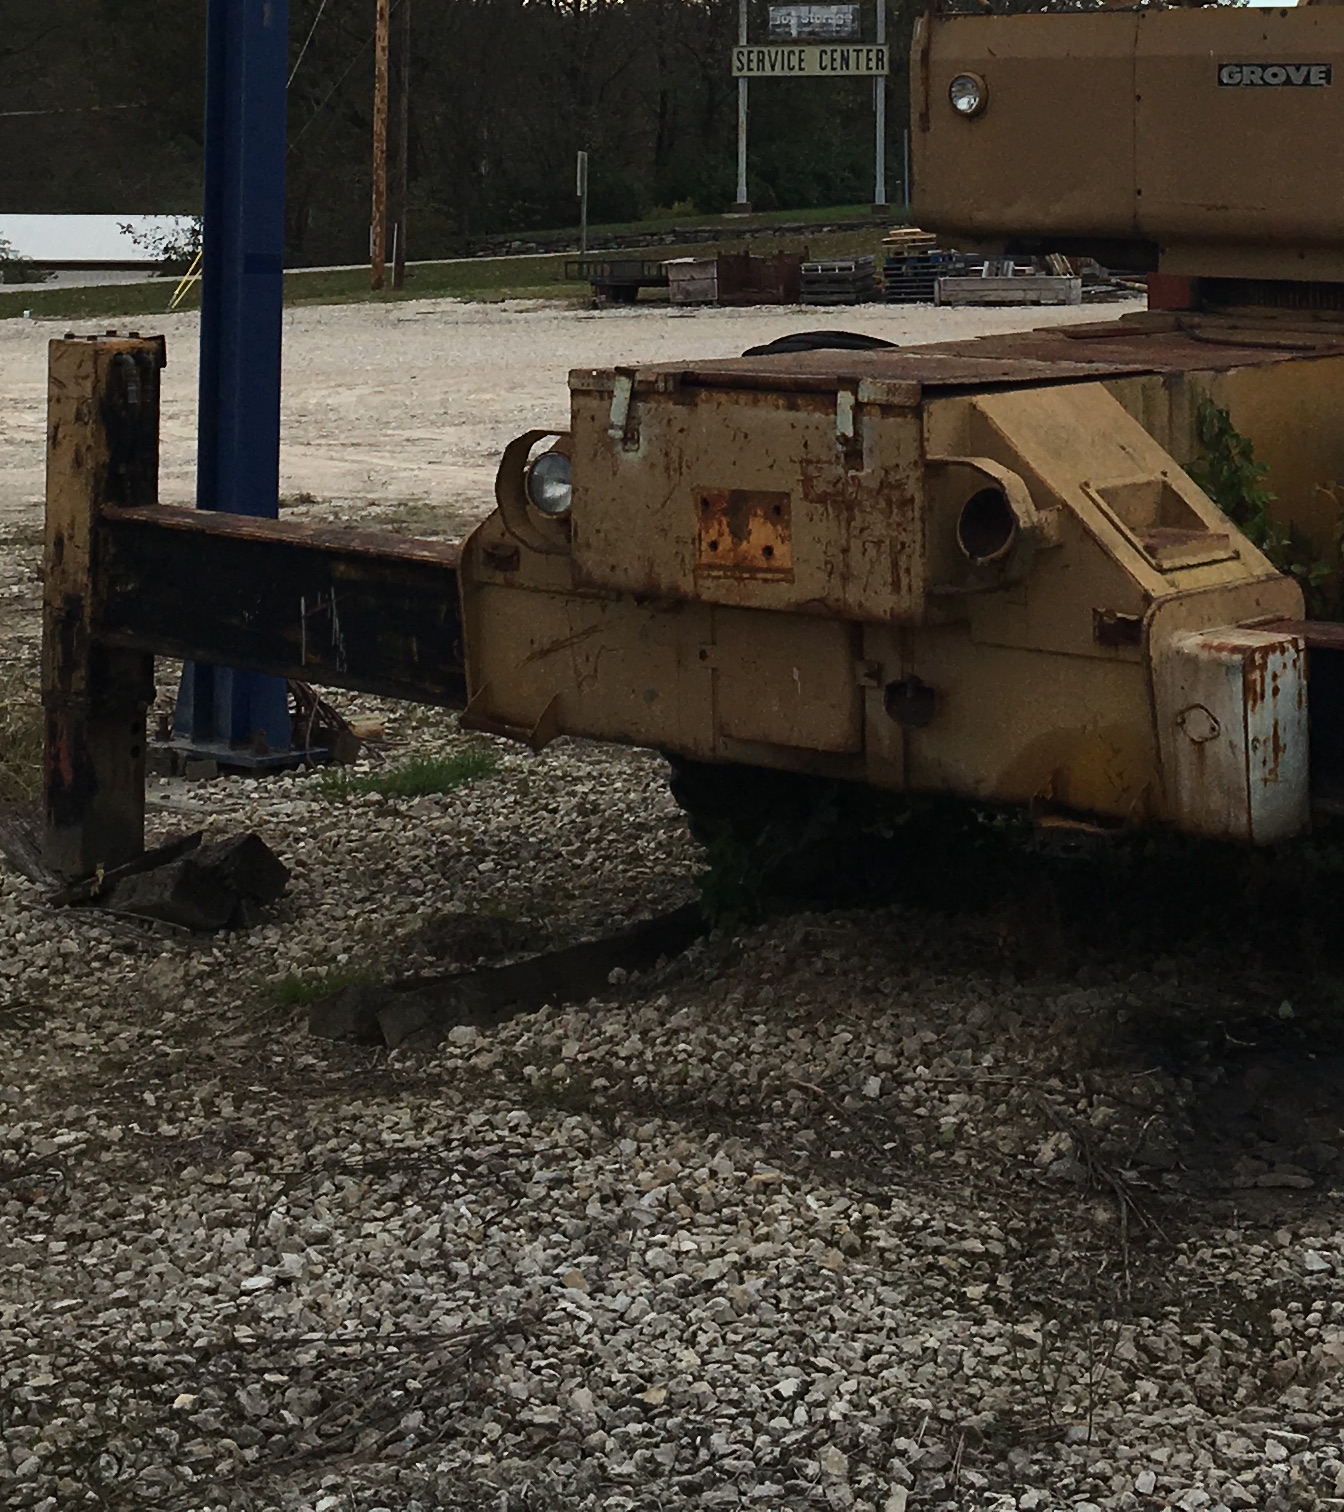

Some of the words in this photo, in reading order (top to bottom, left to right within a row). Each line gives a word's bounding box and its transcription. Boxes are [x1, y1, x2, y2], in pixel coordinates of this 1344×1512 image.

[736, 49, 805, 73] SERVICE
[819, 48, 885, 72] CENTER
[1220, 65, 1327, 85] GROVE
